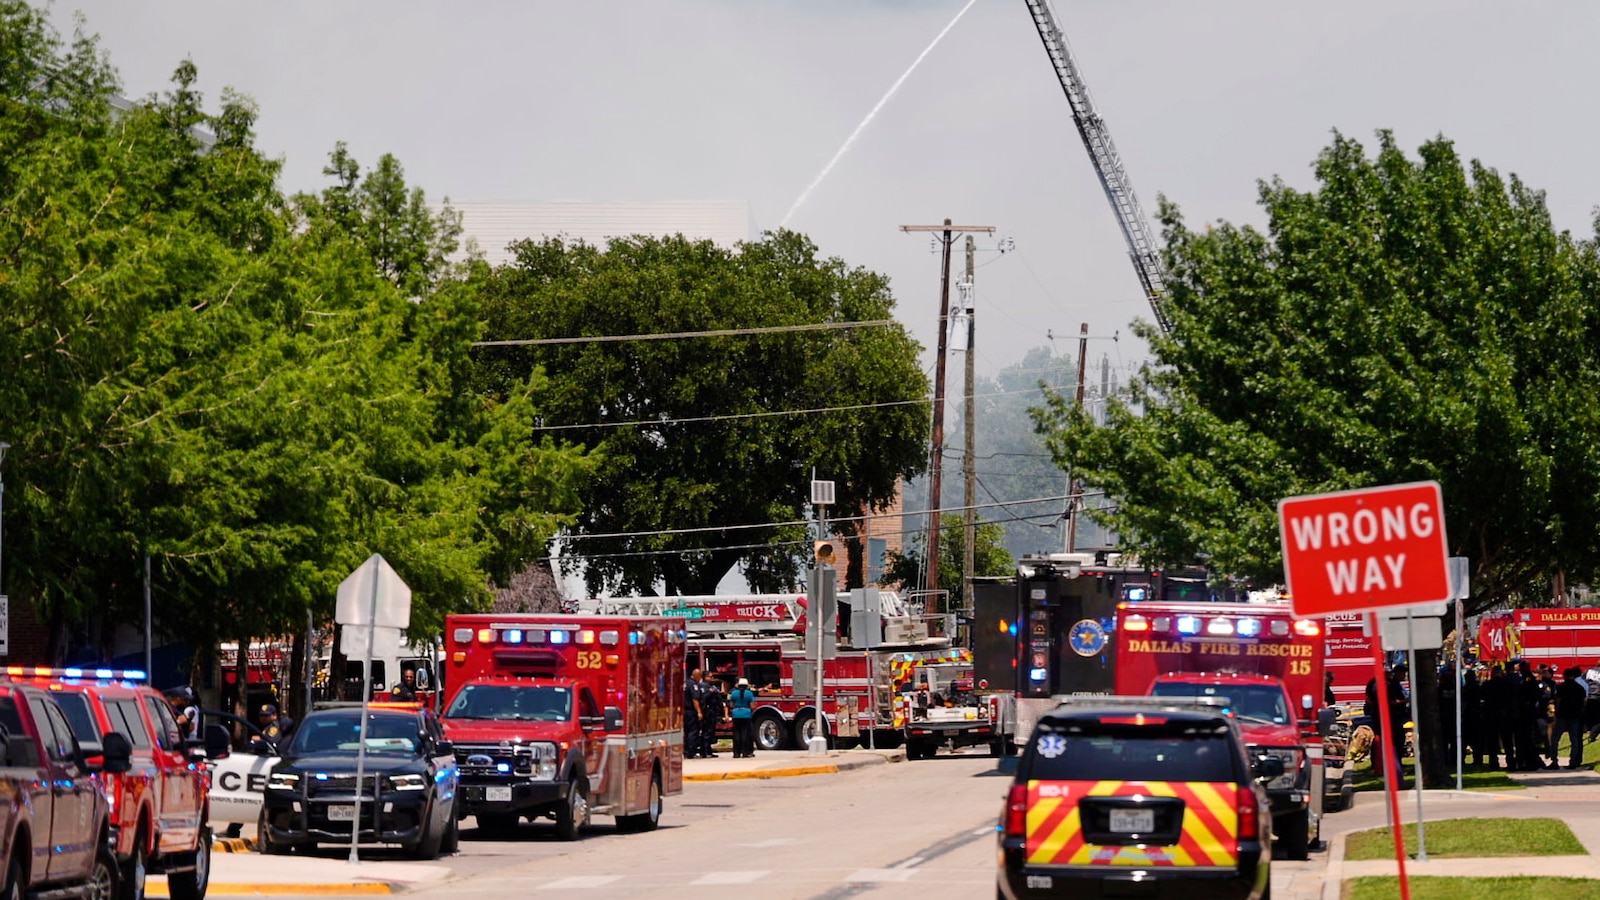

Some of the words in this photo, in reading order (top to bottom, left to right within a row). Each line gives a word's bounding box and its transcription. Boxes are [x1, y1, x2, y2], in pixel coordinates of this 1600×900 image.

[1291, 502, 1434, 551] WRONG
[1326, 553, 1406, 596] WAY
[737, 605, 780, 618] TRUCK
[1325, 612, 1356, 621] SCUE
[1541, 613, 1577, 621] DALLAS
[1128, 640, 1192, 653] DALLAS
[1200, 642, 1240, 656] FIRE
[1246, 644, 1312, 657] RESCUE
[1488, 629, 1503, 651] 14
[576, 651, 602, 669] 52
[1290, 661, 1311, 675] 15
